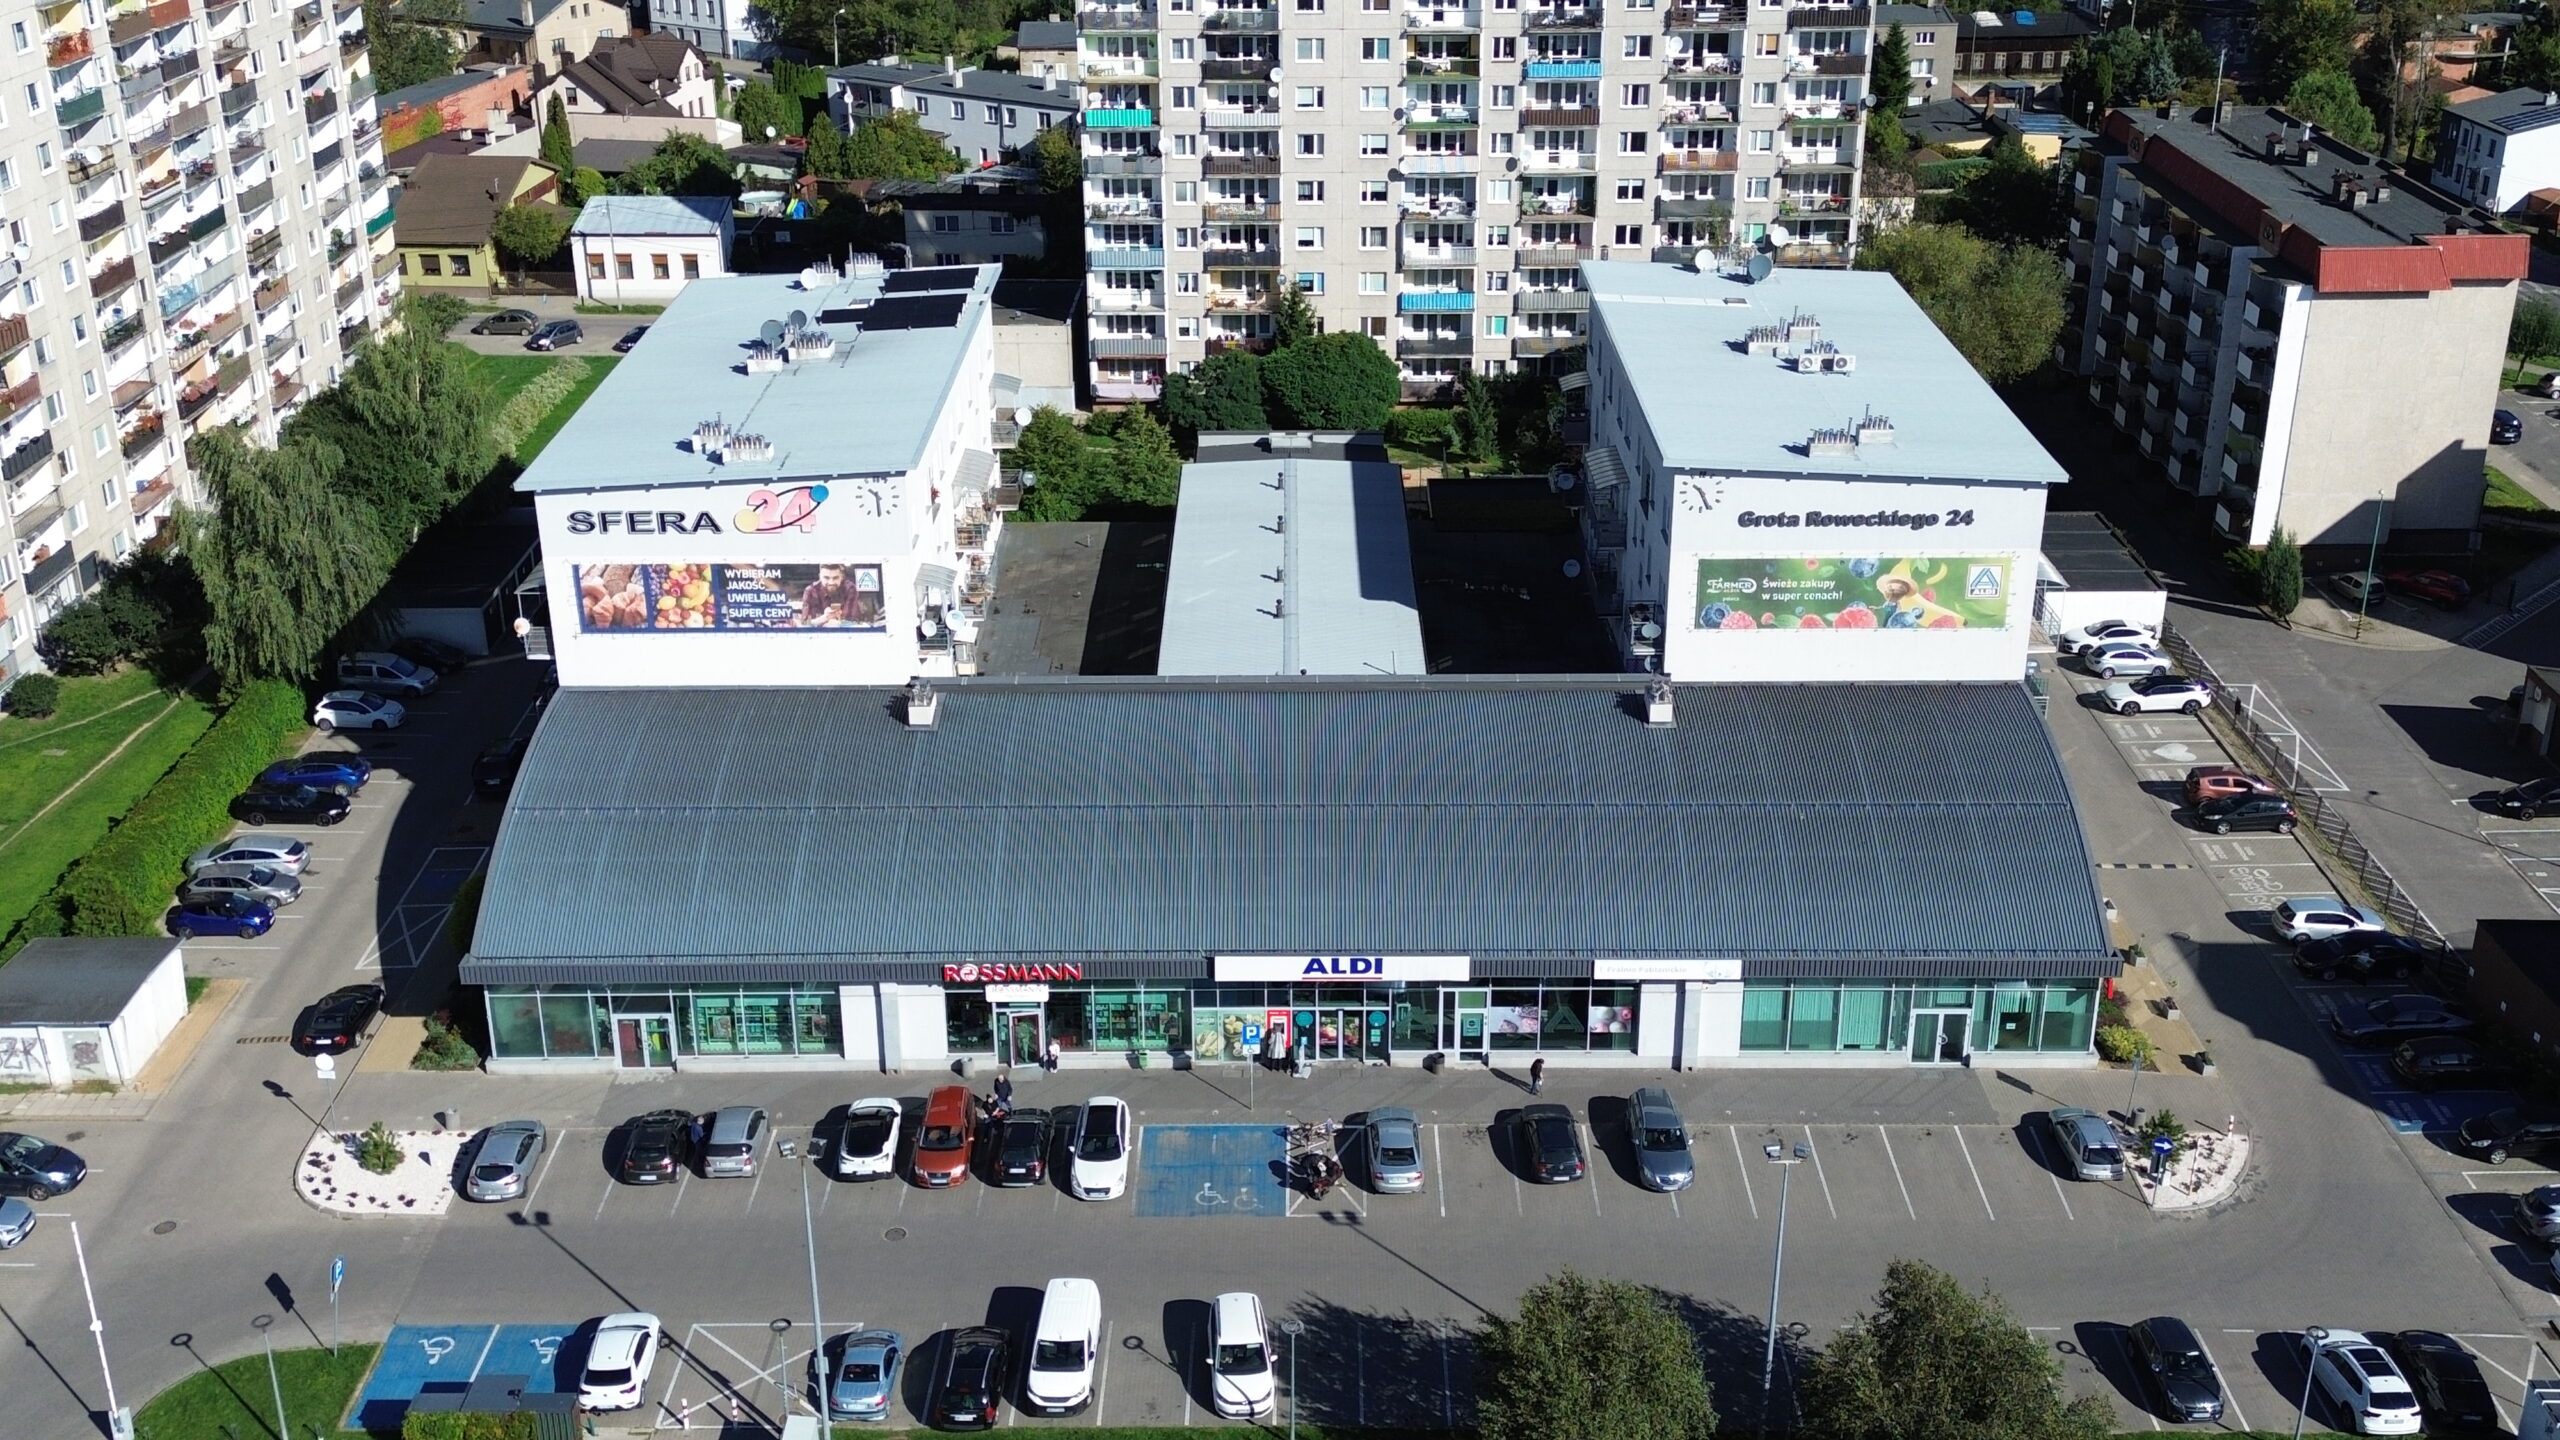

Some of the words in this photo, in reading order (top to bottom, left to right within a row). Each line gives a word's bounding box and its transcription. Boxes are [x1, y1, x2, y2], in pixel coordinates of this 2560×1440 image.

[567, 510, 723, 535] SFERA
[746, 488, 817, 534] 24
[1737, 511, 1800, 528] Grota
[1805, 510, 1940, 531] Roweckiego
[1945, 509, 1975, 527] 24
[724, 569, 782, 579] WYBIERAM
[726, 578, 766, 591] JAKOŚĆ
[1799, 579, 1836, 590] zakupy
[727, 593, 786, 603] UWIELBIAM
[1762, 593, 1771, 601] w
[1772, 593, 1801, 602] super
[1804, 590, 1844, 601] cenach!
[1970, 588, 1999, 596] ALDI
[728, 608, 763, 618] SUPER
[765, 608, 793, 618] CENY
[943, 962, 1082, 981] ROSSMANN
[1302, 957, 1383, 975] ALDI
[1246, 1026, 1257, 1039] P
[335, 1260, 342, 1279] P
